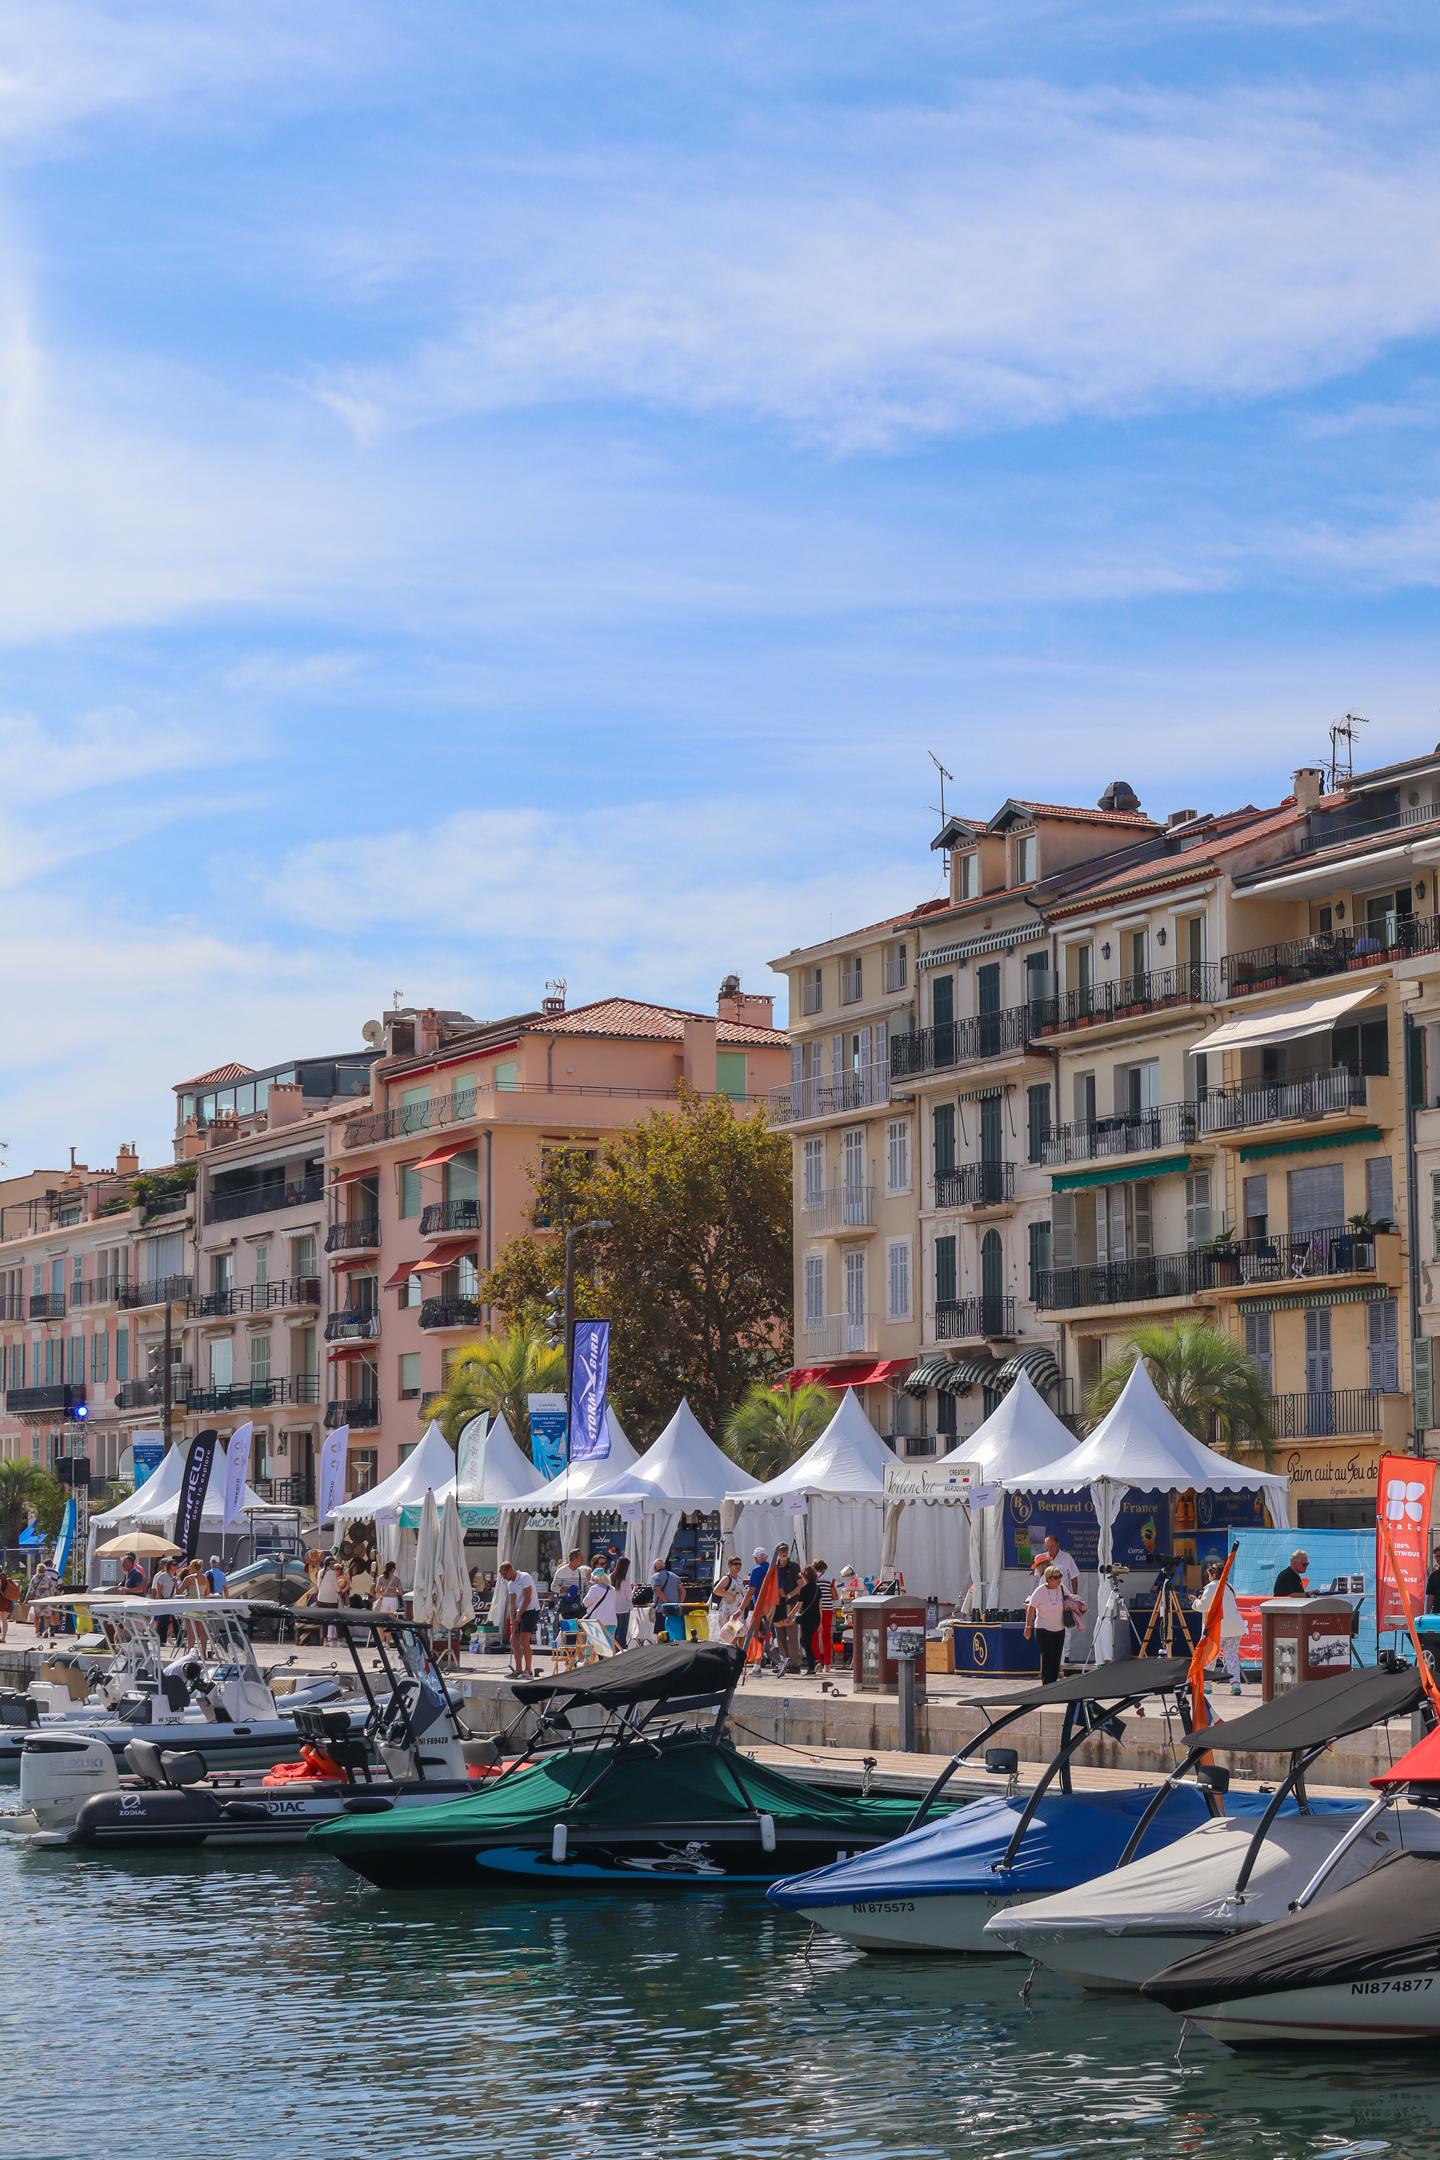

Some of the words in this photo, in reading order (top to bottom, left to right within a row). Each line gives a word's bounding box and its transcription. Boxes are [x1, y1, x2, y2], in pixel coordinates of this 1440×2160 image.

[589, 1332, 599, 1369] BIRD
[588, 1392, 597, 1441] STORM
[192, 1501, 200, 1520] dare
[201, 1450, 211, 1483] explore
[1287, 1452, 1313, 1485] Pain
[1315, 1461, 1334, 1481] cuit
[1335, 1470, 1347, 1481] au
[1367, 1460, 1378, 1479] de
[1038, 1501, 1081, 1512] Bernard
[1123, 1502, 1158, 1513] France
[853, 1903, 866, 1913] NI
[869, 1902, 915, 1913] 875573
